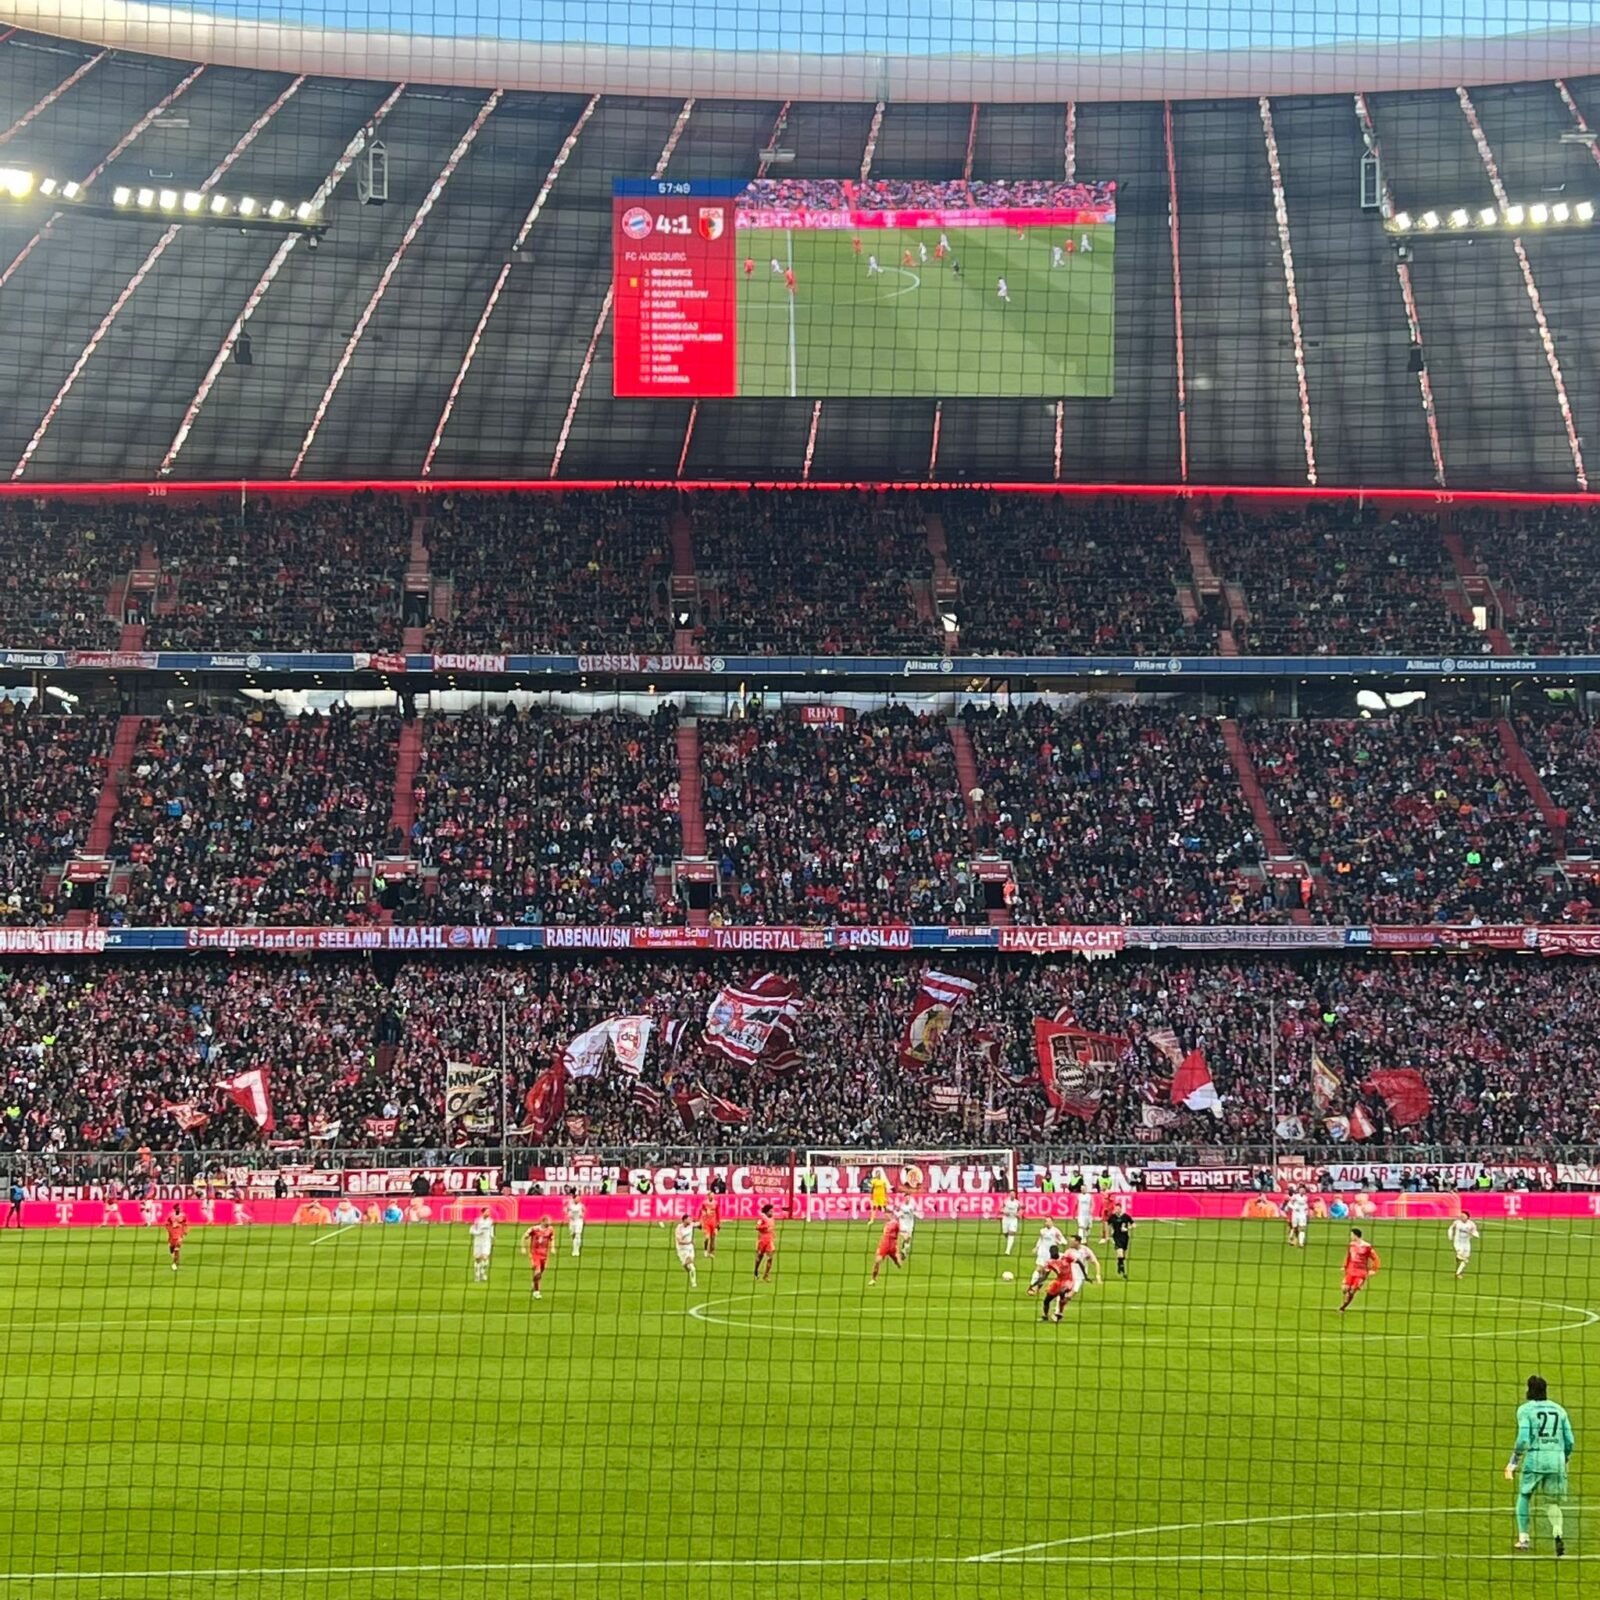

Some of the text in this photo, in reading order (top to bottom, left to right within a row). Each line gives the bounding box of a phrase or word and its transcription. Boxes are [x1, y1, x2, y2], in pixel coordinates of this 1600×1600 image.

[655, 214, 692, 234] 4:1
[625, 252, 637, 261] FC
[7, 654, 42, 666] Allianz
[210, 656, 246, 667] Allianz
[434, 655, 505, 672] MEUCHEN
[578, 655, 712, 672] GIESSEN BULLS
[905, 660, 938, 671] Allianz
[1133, 660, 1166, 671] Allianz
[1406, 660, 1537, 670] Allianz Global Investors
[808, 708, 838, 718] RHM
[189, 929, 315, 948] Sandharlanden
[319, 932, 382, 948] SEELAND
[546, 928, 630, 948] RABENAU/SN
[635, 927, 647, 938] FC
[714, 930, 800, 949] TAUBERTAL
[850, 928, 910, 946] RÖSLAU
[1002, 931, 1122, 947] HAVELMACHT
[1179, 1171, 1251, 1186] FANATIC
[627, 1198, 651, 1217] JE
[724, 1197, 753, 1216] IHR
[1537, 1411, 1559, 1437] 27
